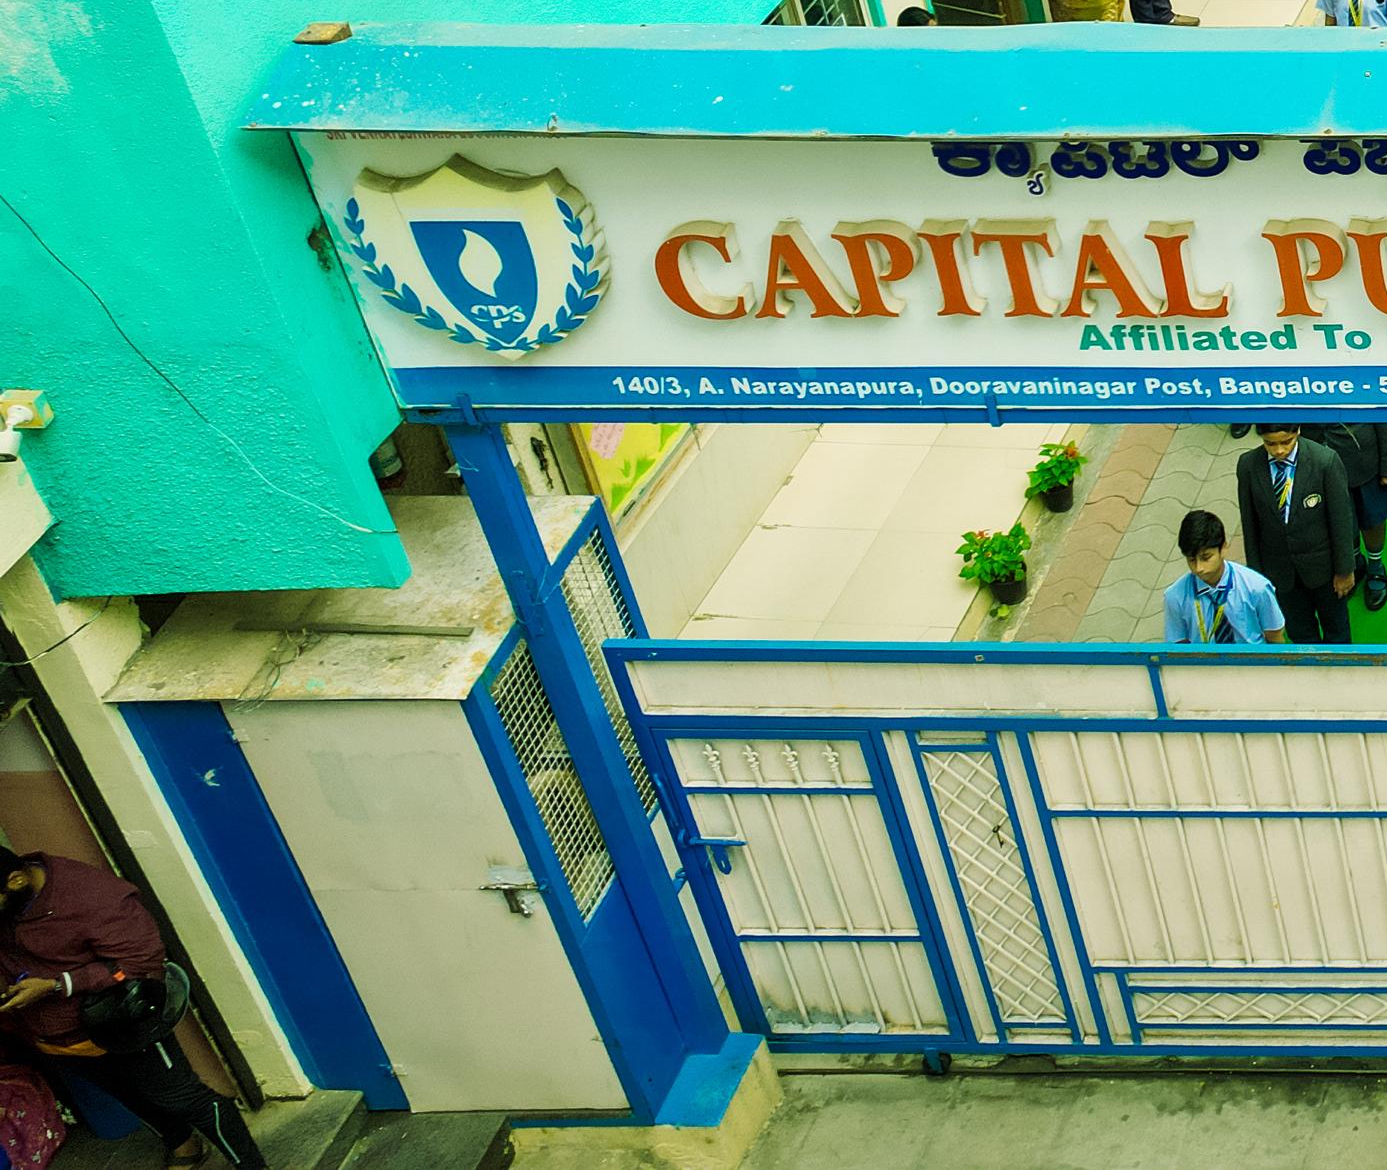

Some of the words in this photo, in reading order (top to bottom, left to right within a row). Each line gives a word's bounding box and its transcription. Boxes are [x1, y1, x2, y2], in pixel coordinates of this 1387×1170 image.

[655, 230, 1230, 320] CAPITAL
[1079, 323, 1298, 351] Affiliated
[1313, 324, 1372, 350] To
[699, 377, 724, 395] A.
[730, 377, 923, 399] Narayanapura,
[930, 377, 1137, 398] Dooravaninagar
[1145, 377, 1212, 398] Post,
[1220, 377, 1355, 398] Bangalore
